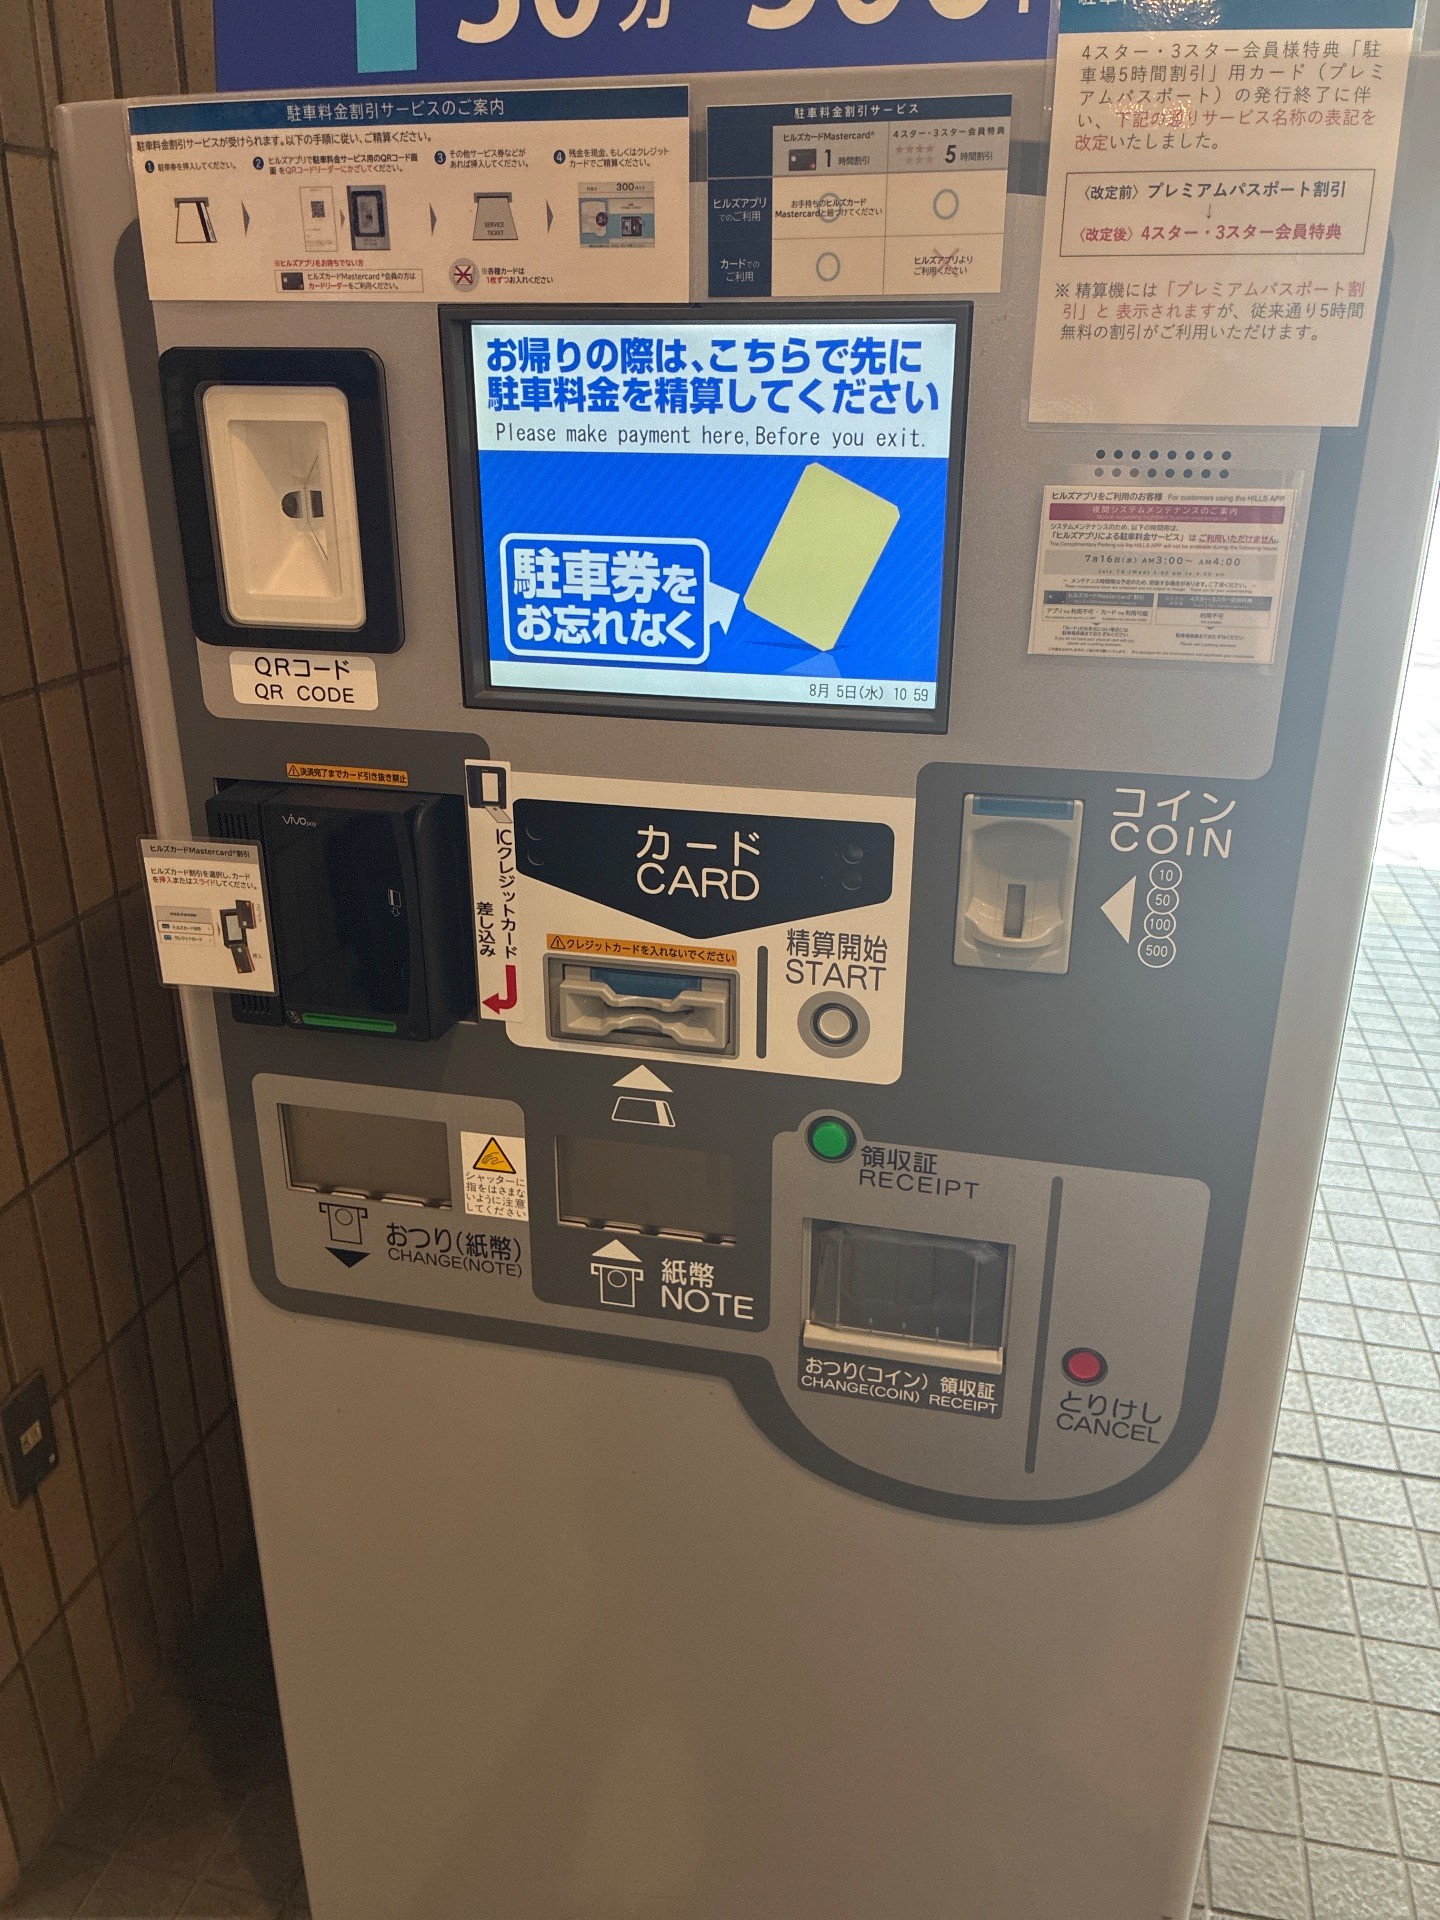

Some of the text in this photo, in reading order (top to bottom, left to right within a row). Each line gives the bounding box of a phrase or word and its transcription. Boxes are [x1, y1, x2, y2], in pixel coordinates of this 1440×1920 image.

[287, 97, 504, 122] 駐車料金割引サービスのご案内
[794, 103, 919, 119] 駐車料金割引サービス
[136, 131, 432, 152] 駐車料金割引サービスが受けられます。以下の手順に従い、ご精算ください。
[1074, 130, 1220, 152] 改定いたしました。
[449, 148, 526, 159] その他サービス券などが
[568, 147, 670, 158] 残金を現金、もしくはクレジット
[838, 155, 871, 166] 時間割引
[945, 144, 993, 163] 5 時間割引
[616, 182, 634, 191] 300
[1148, 180, 1346, 199] プレミアムパスポート割引
[713, 197, 767, 209] ヒルズアプリ
[790, 197, 867, 209] お手持ちのヒルズカード
[719, 211, 761, 222] でのご利用
[1141, 222, 1342, 241] 4スター・3スター会員特典
[720, 259, 760, 270] カードでの
[913, 255, 973, 265] ヒルズアプリより
[726, 271, 754, 282] ご利用
[913, 266, 968, 276] ご利用ください
[1060, 323, 1319, 341] 無料の割引がご利用いただけます。
[486, 337, 923, 375] お帰りの際は、こちらで先に
[487, 376, 939, 415] 駐車料金を精算してください
[496, 423, 556, 443] Please
[566, 424, 607, 443] make
[618, 425, 691, 449] payment
[831, 430, 864, 452] you
[876, 427, 926, 448] exit.
[1052, 491, 1163, 501] ヒルズアプリをご利用のお客様
[513, 547, 697, 603] 駐車券を
[516, 605, 697, 649] お忘れなく
[254, 656, 350, 680] QRコード
[254, 683, 355, 703] QR CODE
[809, 684, 830, 699] 8月
[893, 686, 906, 700] 10
[913, 687, 929, 702] 59
[299, 766, 407, 784] 決済完了までカード引き抜き禁止
[1112, 787, 1236, 824] コイン
[636, 824, 760, 867] カード
[1110, 821, 1233, 859] COIN
[636, 862, 760, 901] CARD
[1159, 868, 1174, 882] 10
[495, 827, 518, 959] ICクレジットカード
[1155, 894, 1171, 907] 50
[477, 901, 496, 957] 差し込み
[1149, 918, 1171, 931] 100
[566, 939, 736, 964] クレジットカードを入れないでください
[786, 928, 888, 965] 精算開始
[1145, 944, 1168, 958] 500
[785, 959, 888, 991] START
[860, 1144, 938, 1176] 領収証
[465, 1171, 526, 1188] シャッターに
[466, 1181, 526, 1198] 指をはさまな
[859, 1169, 979, 1199] RECEIPT
[466, 1193, 527, 1209] いように注意
[466, 1203, 527, 1218] してください
[387, 1248, 523, 1278] CHANGE(NOTE)
[660, 1257, 715, 1289] 紙幣
[660, 1287, 755, 1321] NOTE
[801, 1374, 998, 1414] CHANGE(COIN) RECEIPT
[939, 1375, 996, 1401] 領収証
[1060, 1390, 1163, 1425] とりけし
[1056, 1412, 1161, 1444] CANCEL
